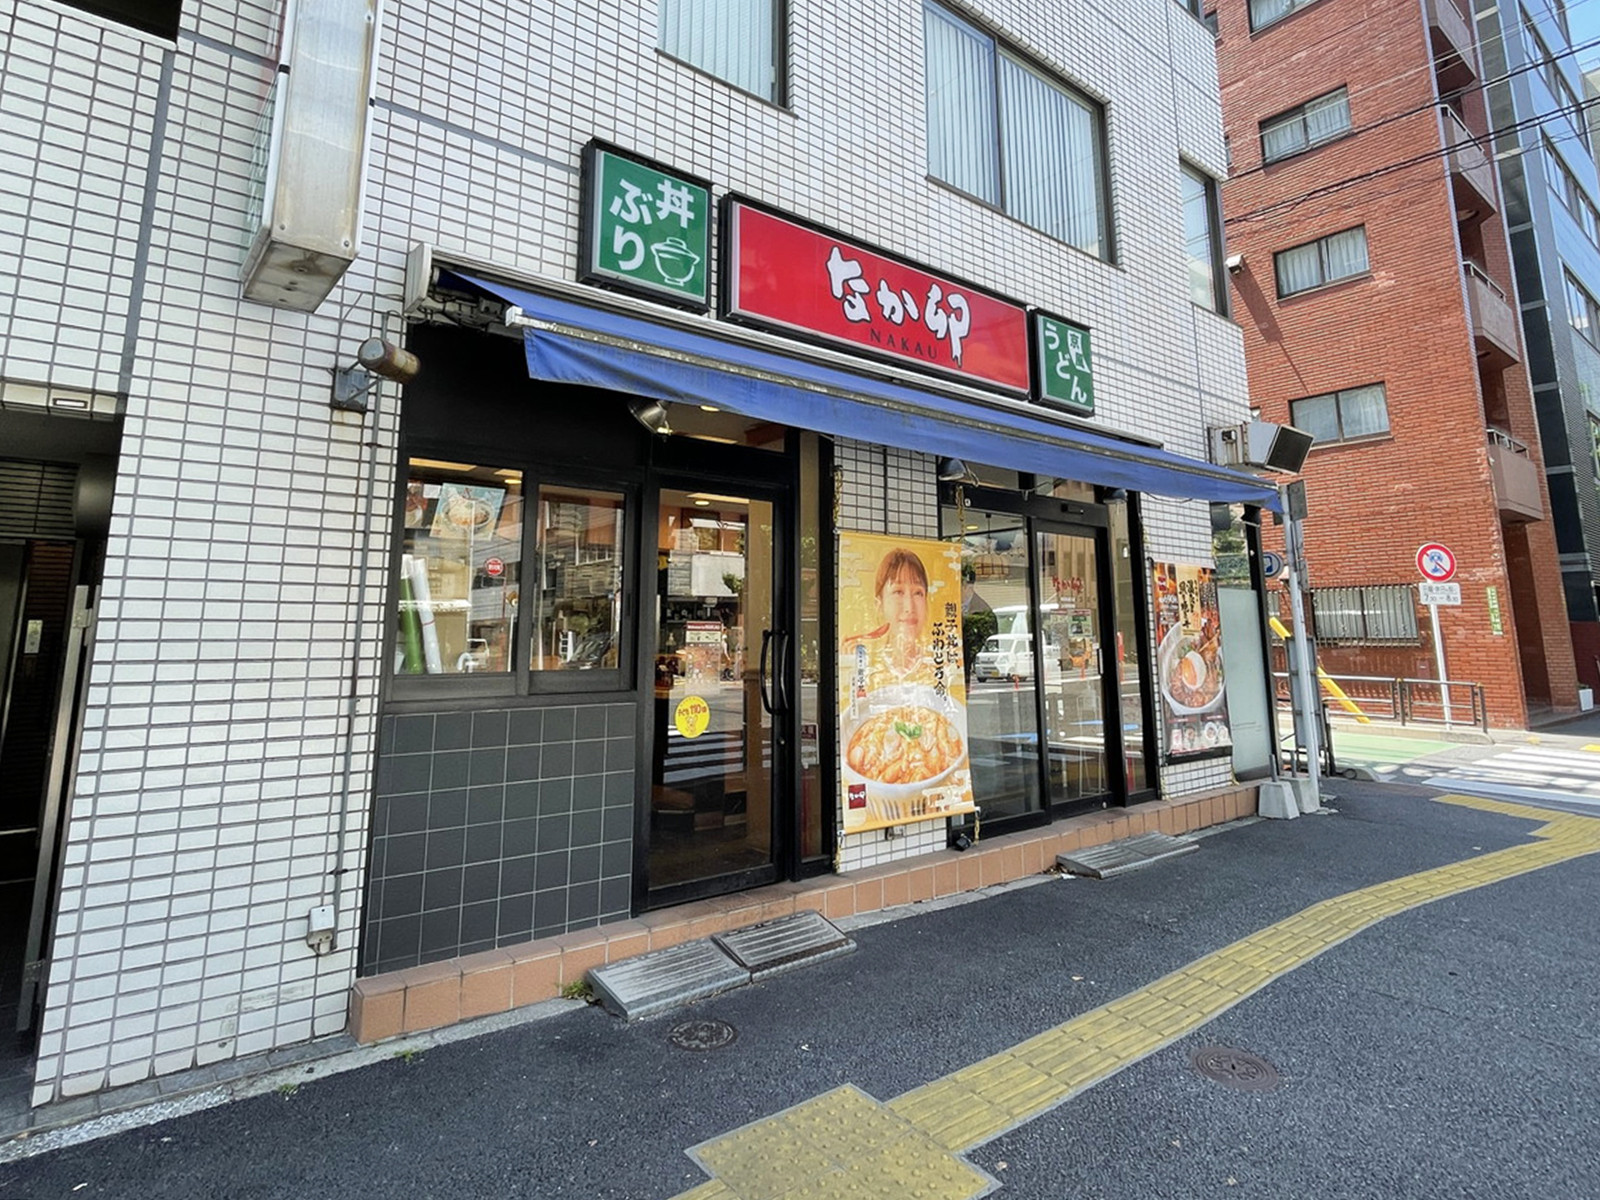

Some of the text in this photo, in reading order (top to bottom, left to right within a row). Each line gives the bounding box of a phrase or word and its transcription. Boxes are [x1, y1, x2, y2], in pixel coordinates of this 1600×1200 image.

[826, 245, 971, 368] なか卯
[869, 328, 938, 359] NAKAU
[1045, 322, 1087, 403] うどん
